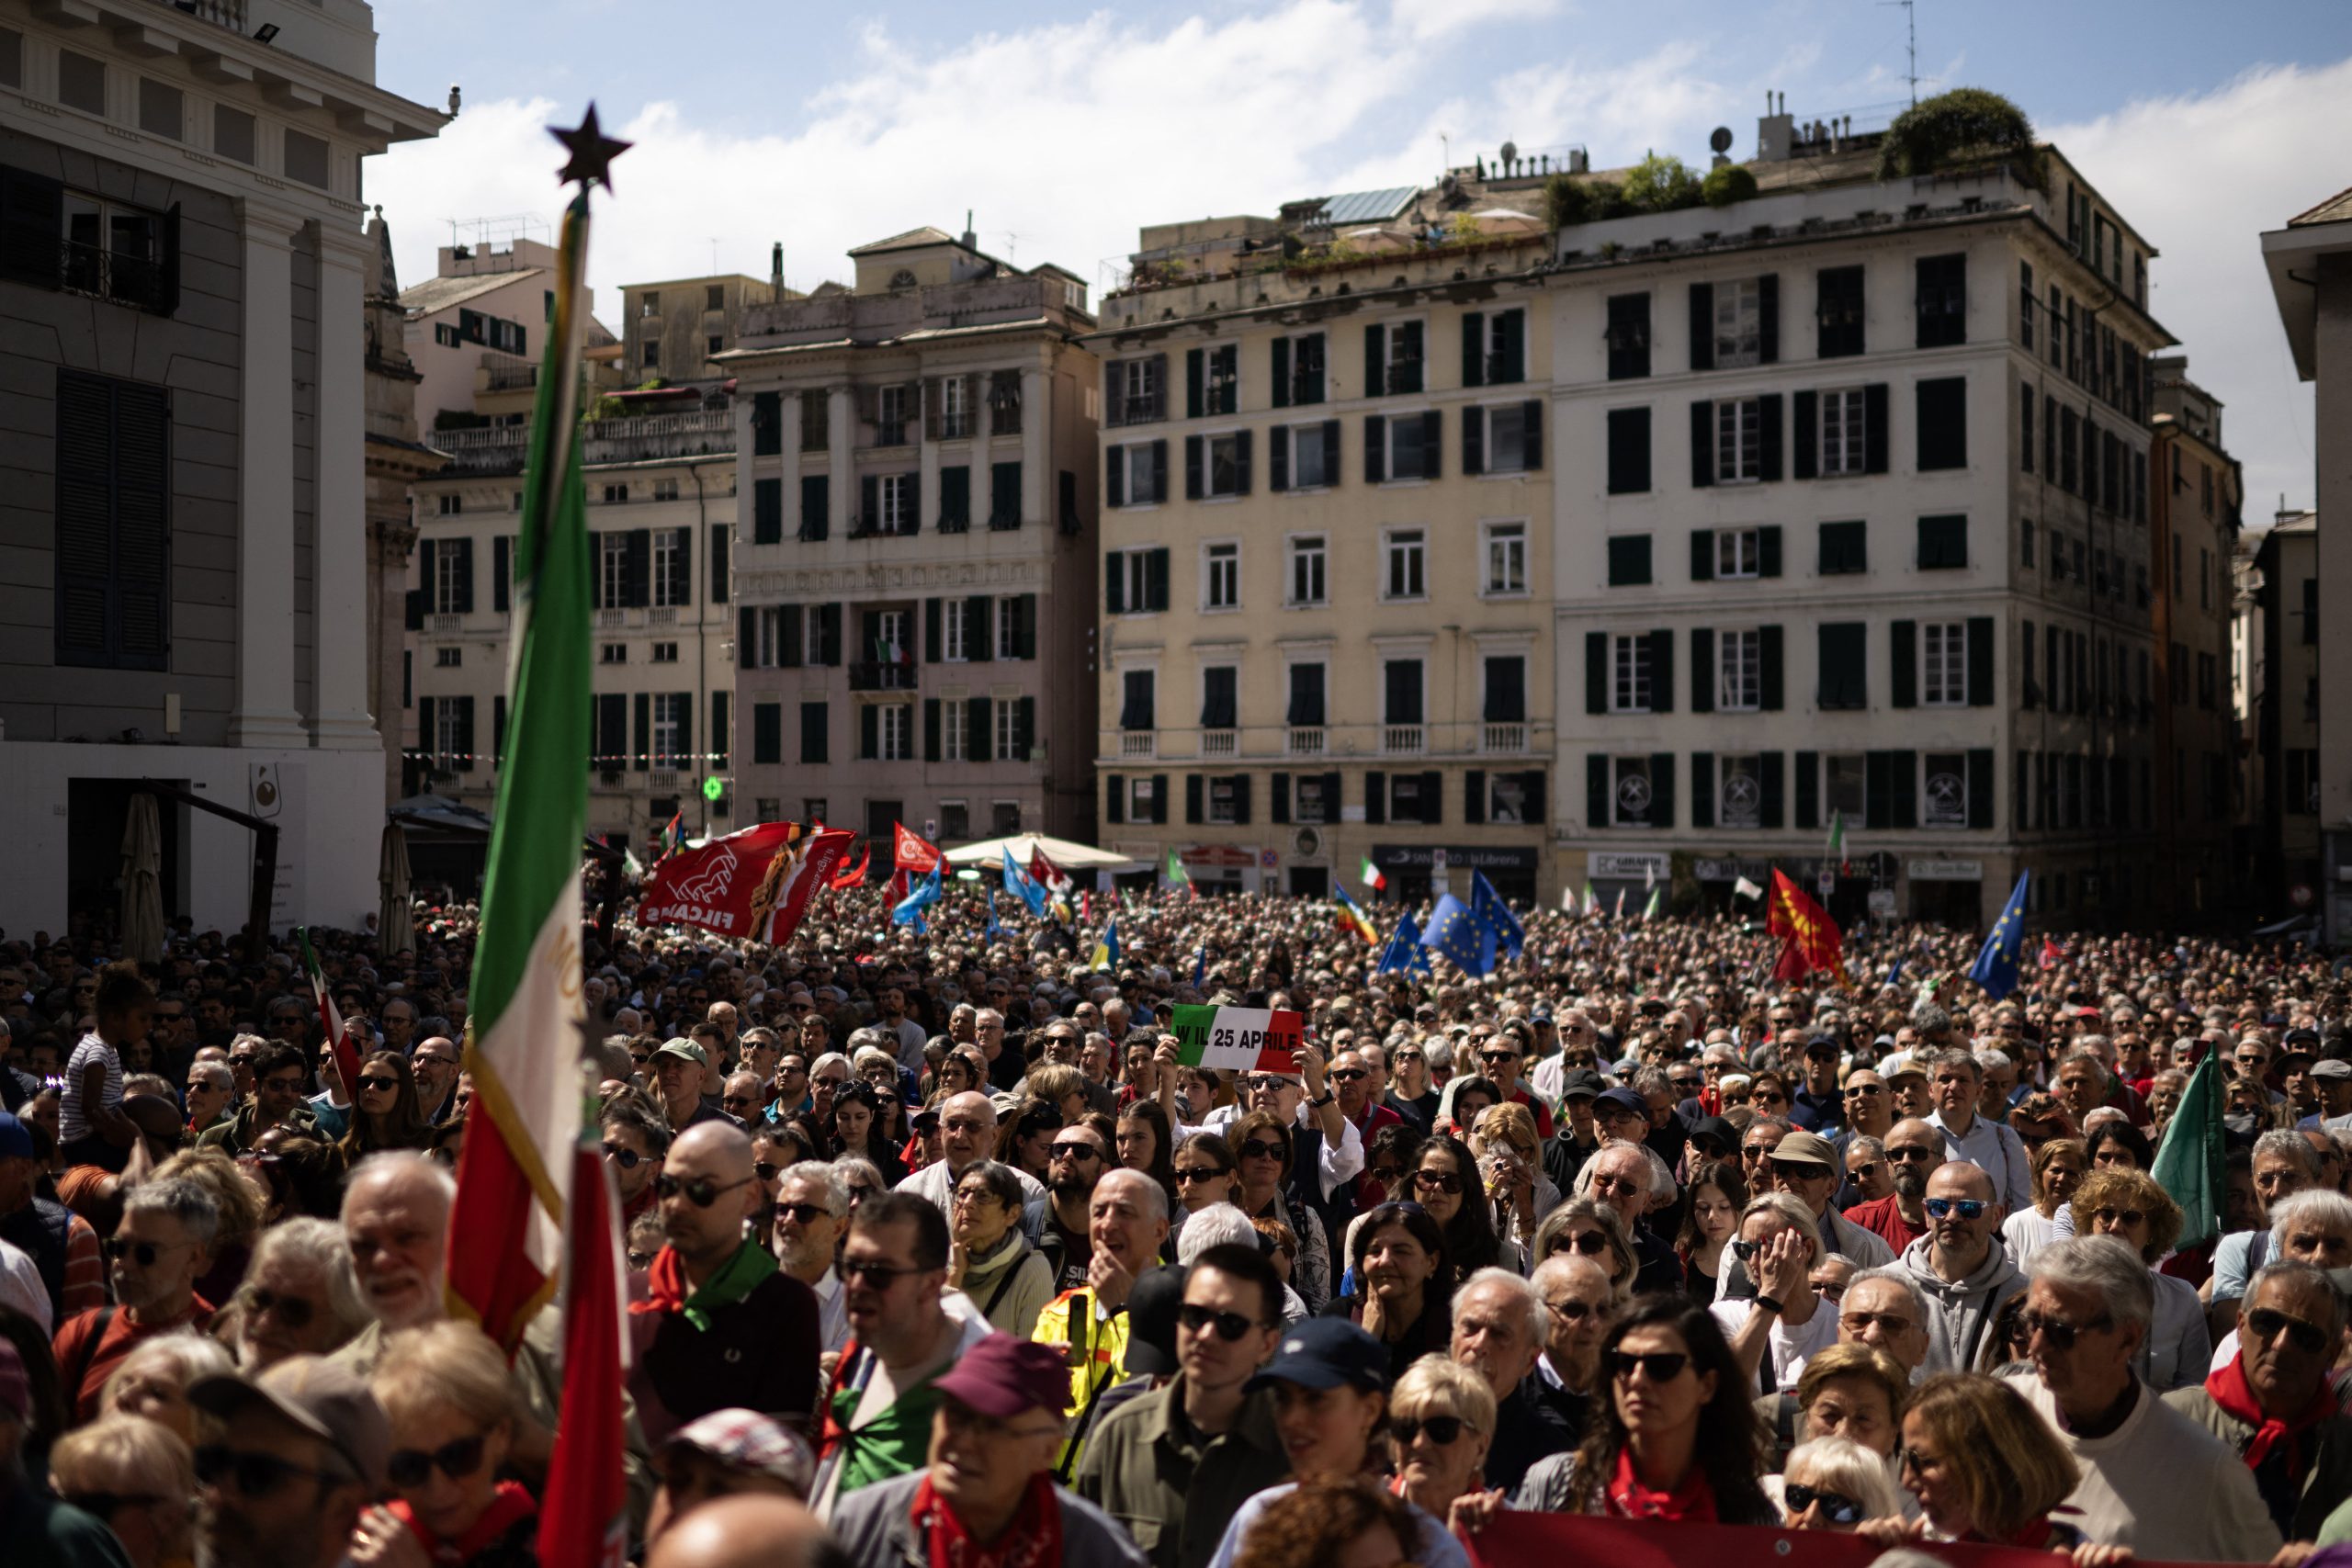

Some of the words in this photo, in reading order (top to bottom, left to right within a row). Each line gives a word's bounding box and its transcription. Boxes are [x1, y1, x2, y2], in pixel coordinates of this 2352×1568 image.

[1176, 1025, 1191, 1044] W
[1195, 1026, 1208, 1046] IL
[1214, 1028, 1235, 1047] 25
[1238, 1030, 1297, 1052] APRILE
